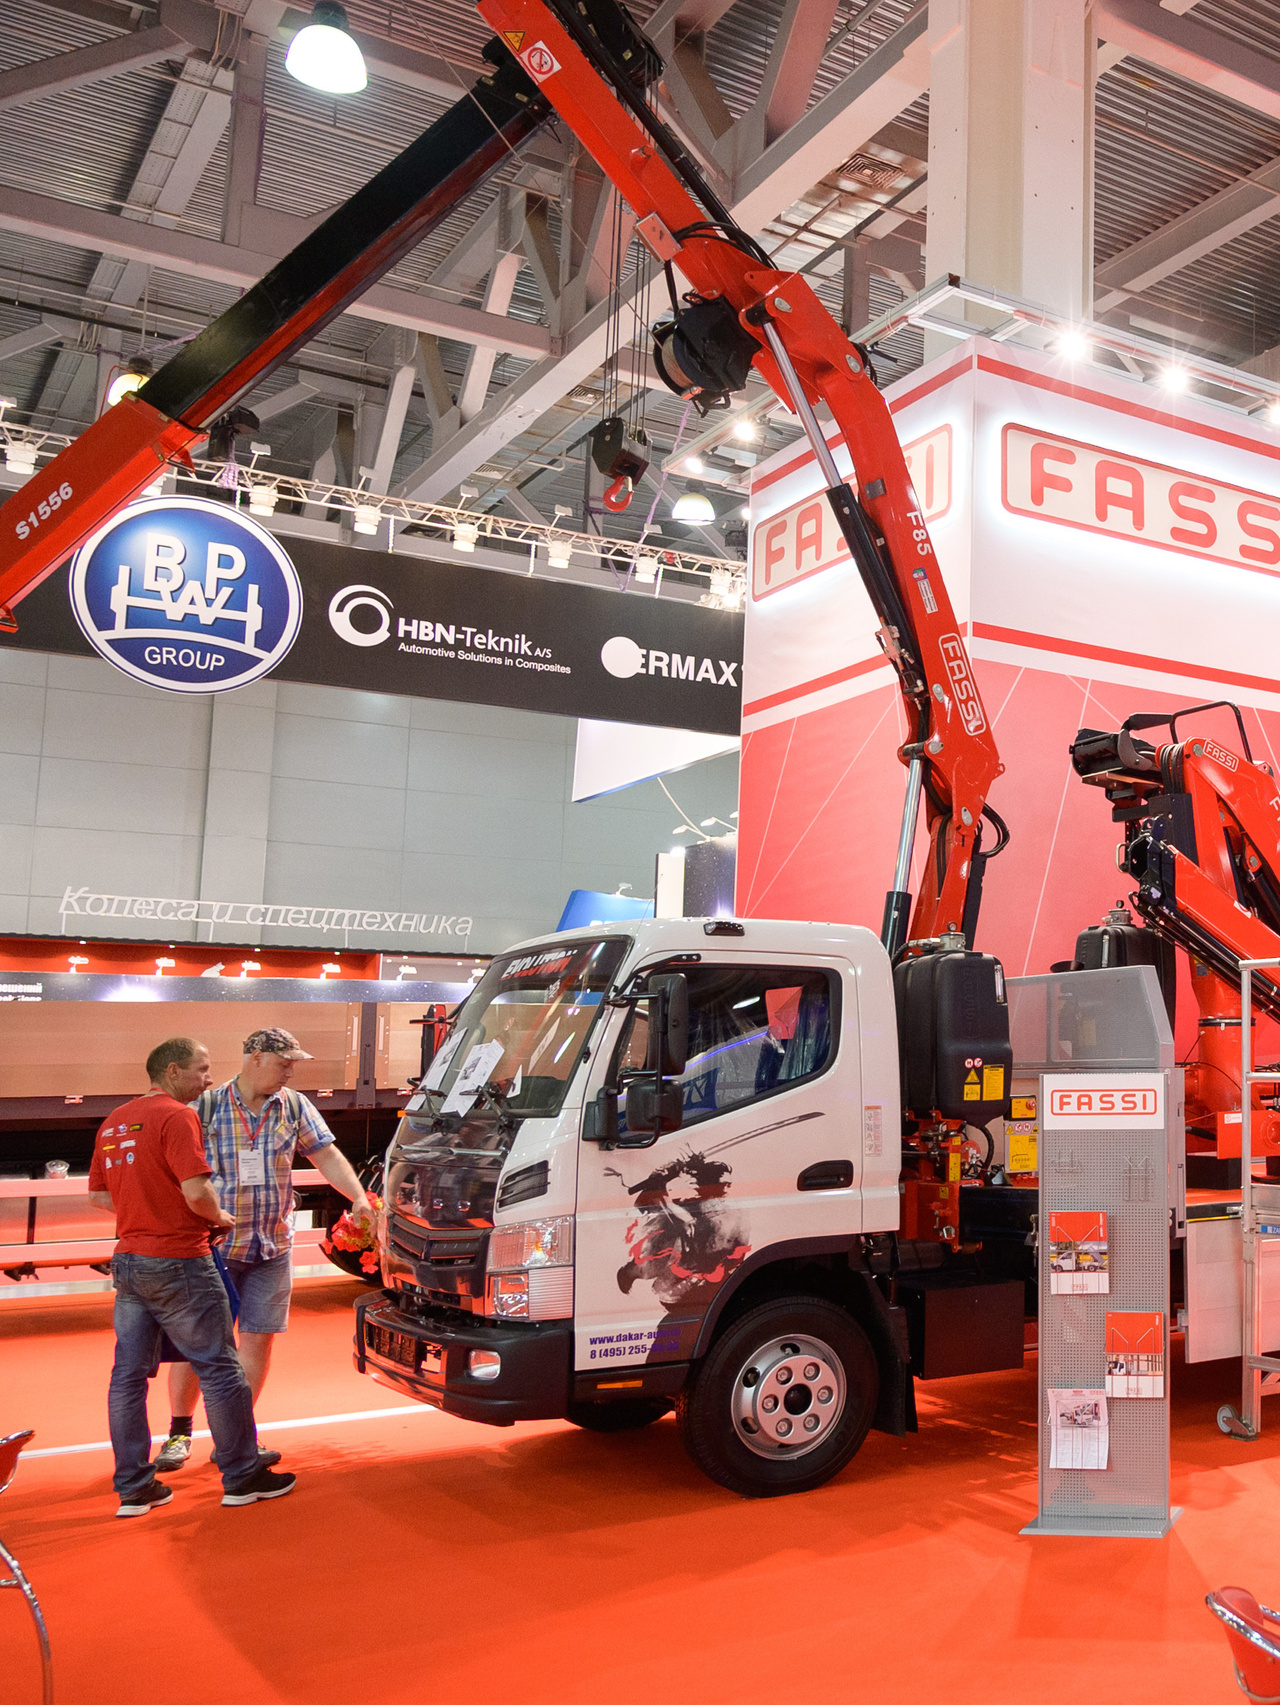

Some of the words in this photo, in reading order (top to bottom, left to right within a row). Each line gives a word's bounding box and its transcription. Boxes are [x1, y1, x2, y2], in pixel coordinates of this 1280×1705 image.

[15, 482, 73, 540] S1556
[765, 443, 934, 586] FAI
[906, 511, 932, 556] F85
[397, 617, 533, 656] HBN-Teknik
[534, 647, 552, 658] A/S
[398, 642, 456, 659] Automotive
[457, 650, 502, 665] Solutions
[504, 656, 514, 666] in
[515, 658, 571, 674] Composites
[144, 646, 226, 671] GROUP
[942, 640, 983, 733] FASSI
[1205, 744, 1237, 770] FASSI
[58, 886, 199, 921] Колеса
[212, 903, 232, 923] и
[245, 907, 474, 936] спецтехника
[1058, 1093, 1149, 1111] FASSI
[590, 1350, 597, 1359] 8
[599, 1347, 626, 1359] (495)
